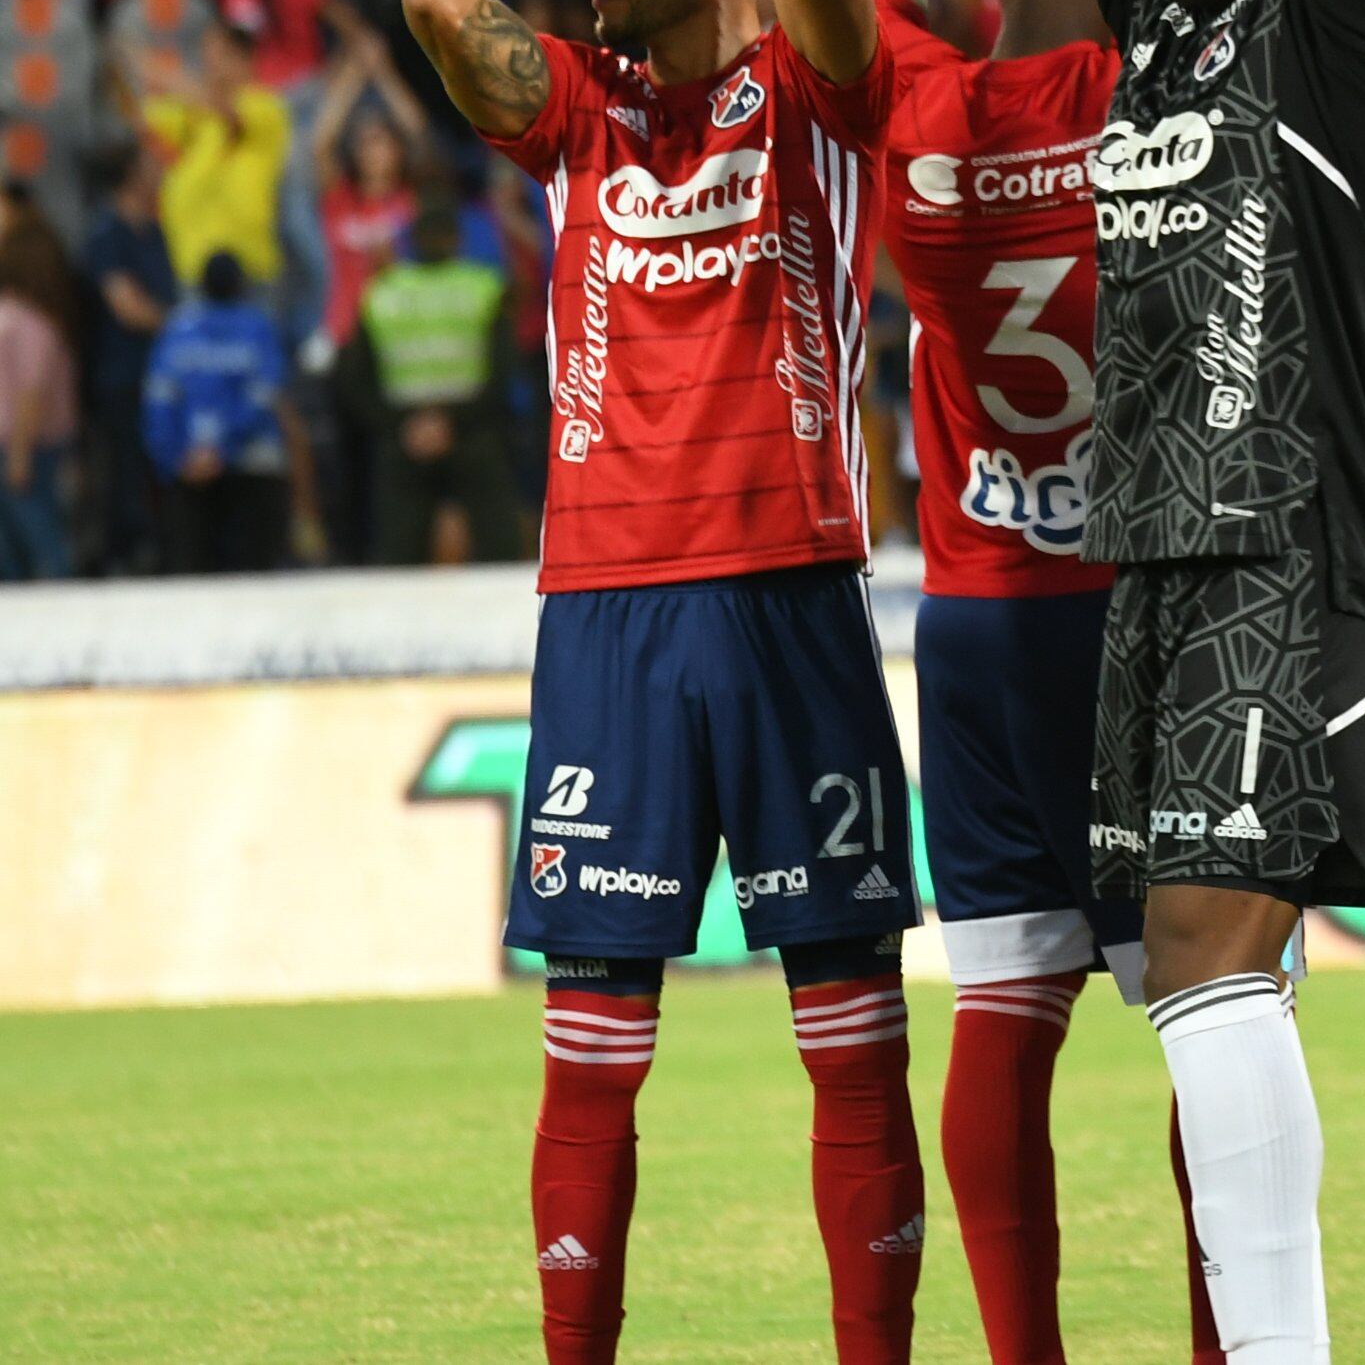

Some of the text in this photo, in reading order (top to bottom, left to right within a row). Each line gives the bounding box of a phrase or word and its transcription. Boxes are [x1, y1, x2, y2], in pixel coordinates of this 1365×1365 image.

[973, 148, 1100, 202] Cotraf
[976, 256, 1096, 435] 3
[1195, 310, 1226, 384] Ron
[966, 433, 1094, 548] tig
[809, 766, 885, 859] 21
[578, 864, 681, 900] Wplay.co
[734, 865, 810, 910] gana
